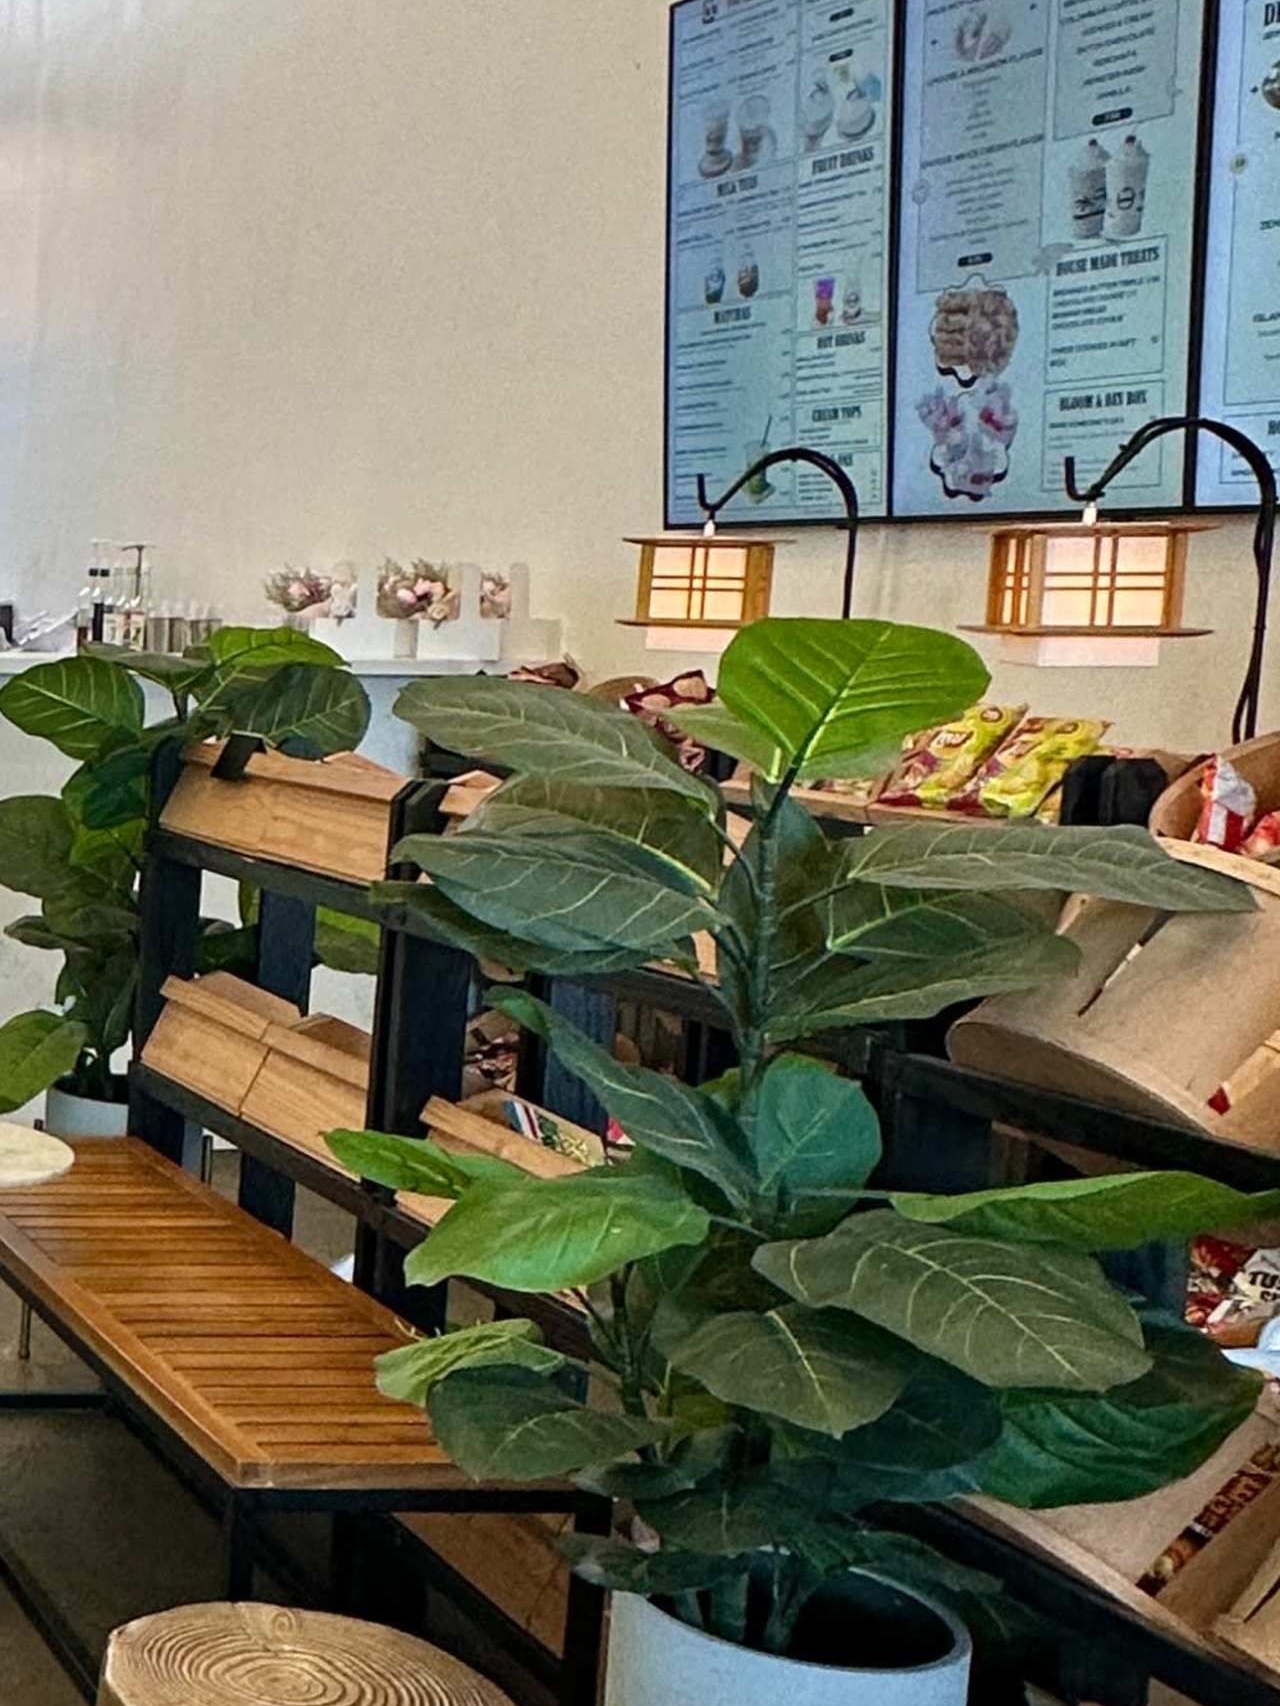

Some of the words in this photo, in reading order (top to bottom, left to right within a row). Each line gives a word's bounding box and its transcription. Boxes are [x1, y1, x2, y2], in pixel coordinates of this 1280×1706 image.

[1056, 256, 1087, 277] HOUSE
[1089, 252, 1118, 272] MADE
[1120, 246, 1160, 267] TREATS
